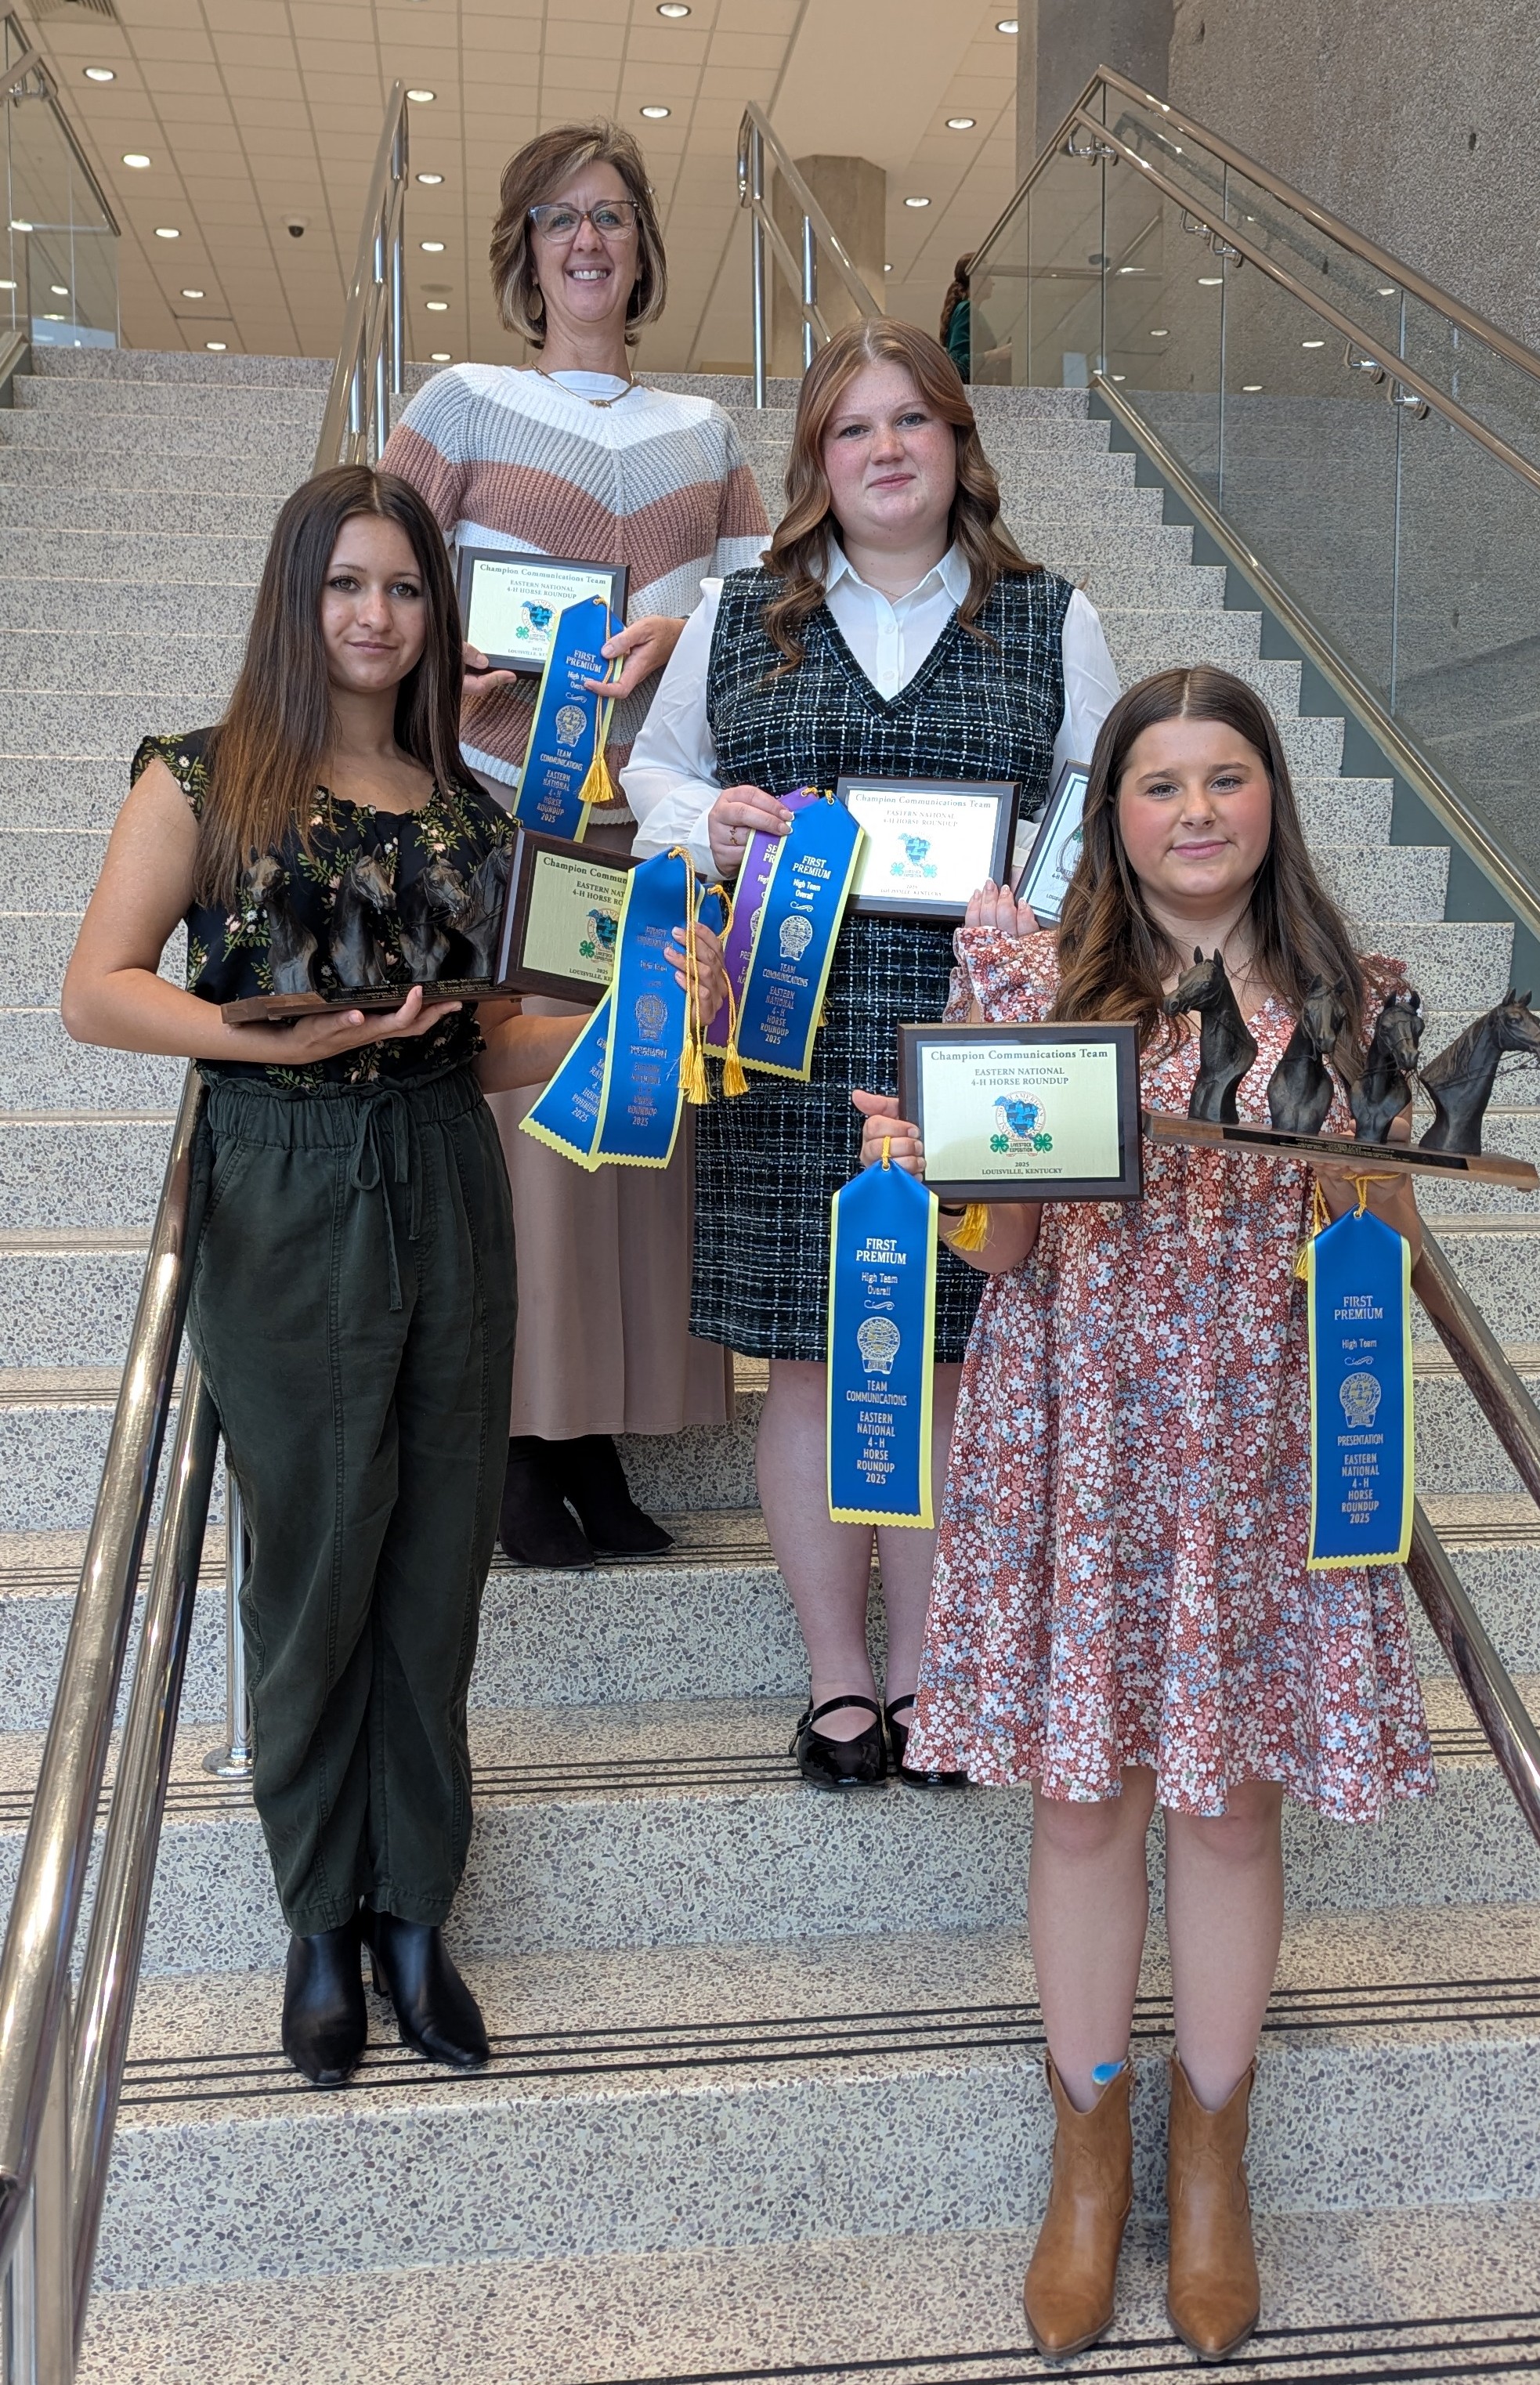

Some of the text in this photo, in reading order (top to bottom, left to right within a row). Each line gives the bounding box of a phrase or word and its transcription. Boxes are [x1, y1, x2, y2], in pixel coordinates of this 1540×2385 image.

[480, 564, 606, 584] Champion Communications Team
[510, 580, 574, 592] EASTERN NATIONAL
[544, 590, 577, 599] ROUNDUP
[573, 649, 596, 663] FIRST
[566, 656, 602, 673] PREMIUM
[557, 748, 572, 758] TEAM
[546, 769, 571, 782] EASTERN
[855, 793, 991, 808] Champion Communications Team
[540, 812, 555, 822] 2025
[543, 857, 587, 874] Champion
[802, 855, 827, 868] FIRST
[792, 862, 831, 880] PREMIUM
[577, 880, 609, 894] EASTERN
[793, 878, 821, 891] High Team
[573, 888, 585, 898] 4-H
[587, 891, 612, 903] HORSE
[795, 889, 814, 900] Overall
[779, 963, 797, 974] TEAM
[769, 985, 795, 999] EASTERN
[766, 1014, 787, 1027] HORSE
[760, 1022, 790, 1036] ROUNDUP
[765, 1033, 781, 1045] 2025
[931, 1049, 1108, 1062] Champion Communications Team
[974, 1067, 1065, 1076] EASTERN NATIONAL
[989, 1077, 1021, 1086] HORSE
[1022, 1077, 1069, 1086] ROUNDUP
[866, 1238, 898, 1251] FIRST
[855, 1249, 907, 1265] PREMIUM
[862, 1271, 898, 1284] High Team
[867, 1285, 891, 1296] Overall
[1343, 1295, 1373, 1307] FIRST
[1334, 1307, 1383, 1321] PREMIUM
[1342, 1338, 1377, 1350] High Team
[867, 1379, 887, 1392] TEAM
[846, 1389, 907, 1406] COMMUNICATIONS
[859, 1411, 893, 1424] EASTERN
[856, 1423, 895, 1437] NATIONAL
[1337, 1433, 1384, 1447] PRESENTATION
[863, 1447, 889, 1461] HORSE
[1344, 1453, 1377, 1465] EASTERN
[856, 1459, 895, 1473] ROUNDUP
[1341, 1464, 1380, 1477] NATIONAL
[866, 1473, 886, 1485] 2025
[1348, 1489, 1373, 1501] HORSE
[1341, 1500, 1379, 1512] ROUNDUP
[1350, 1512, 1370, 1524] 2025
